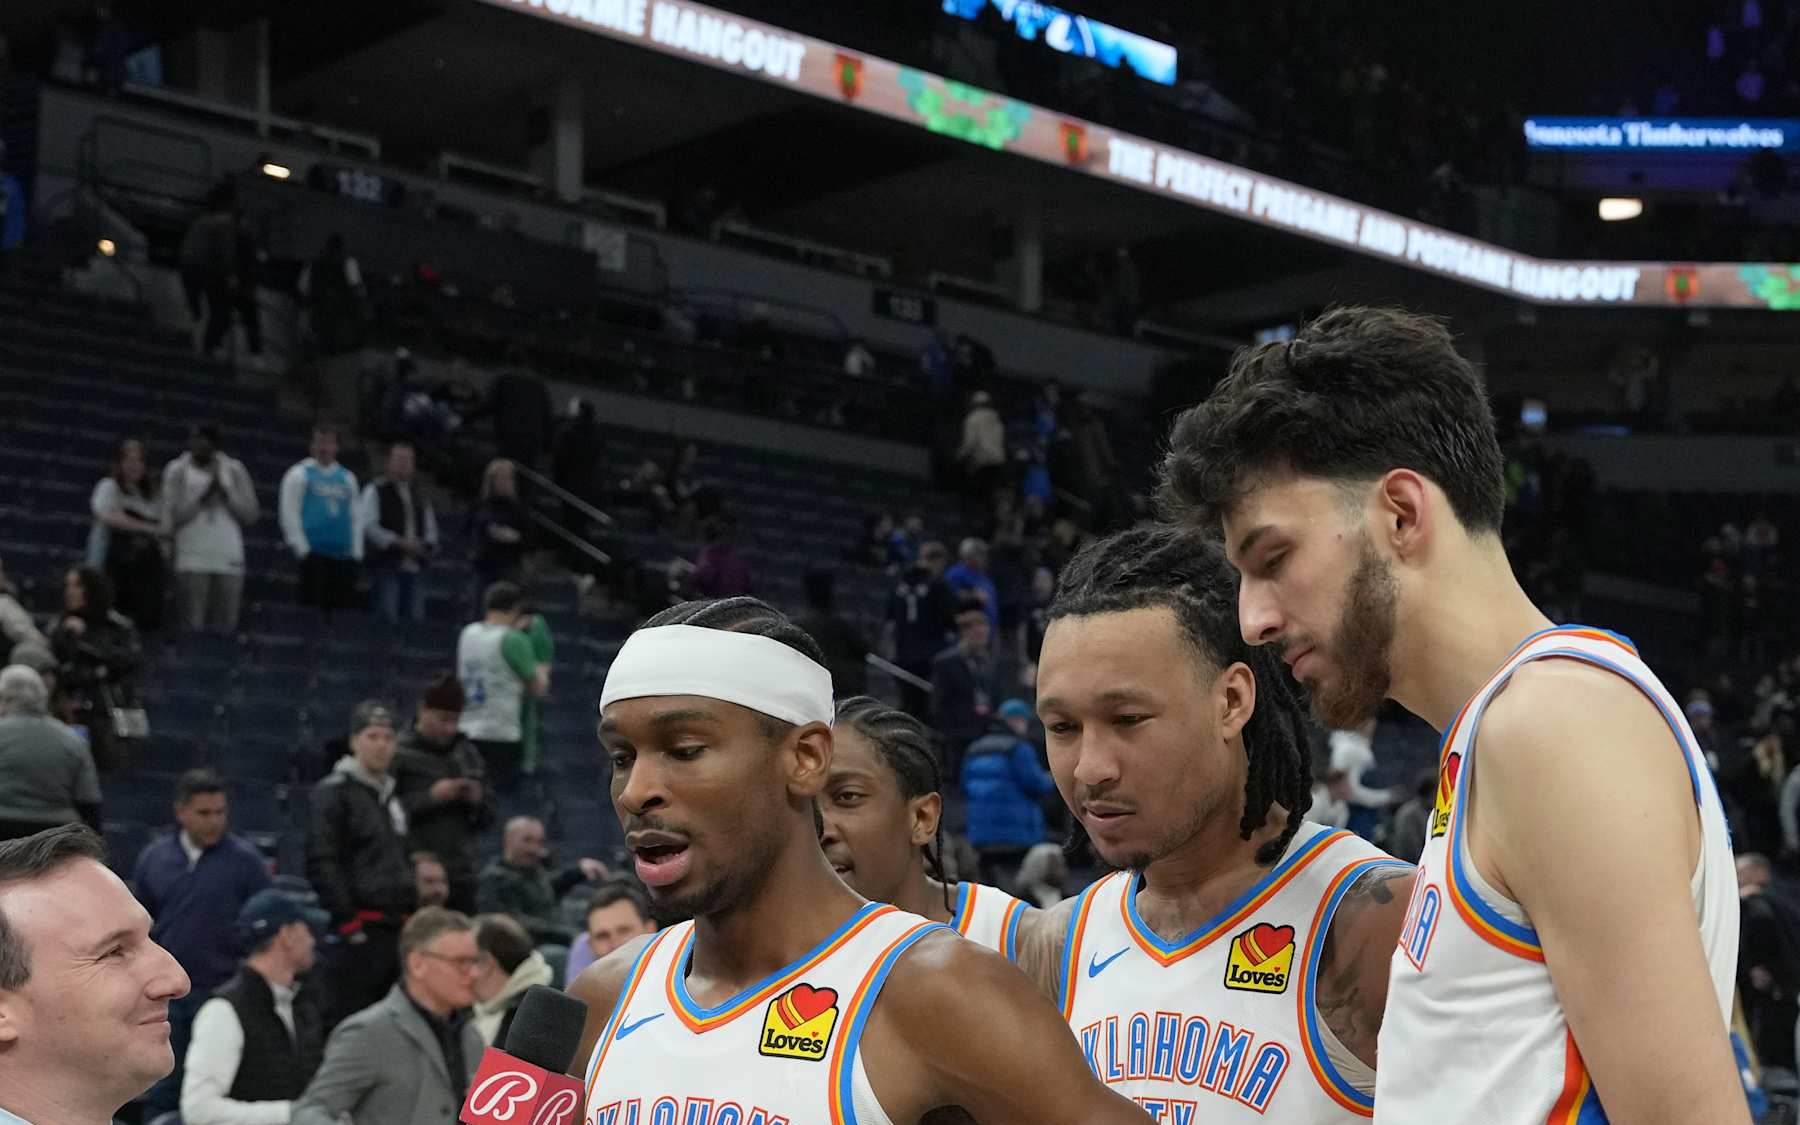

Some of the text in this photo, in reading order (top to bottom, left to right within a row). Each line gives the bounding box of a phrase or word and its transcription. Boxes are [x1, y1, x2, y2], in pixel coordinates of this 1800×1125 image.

[651, 3, 806, 82] HANGOUT
[1622, 121, 1784, 147] Timberwolves
[1108, 136, 1155, 184] THE
[1155, 151, 1253, 210] PERFECT
[1359, 212, 1406, 256] AND
[1511, 258, 1640, 300] HANGOUT
[469, 1070, 538, 1121] B
[1081, 1011, 1290, 1115] KLAHOMA
